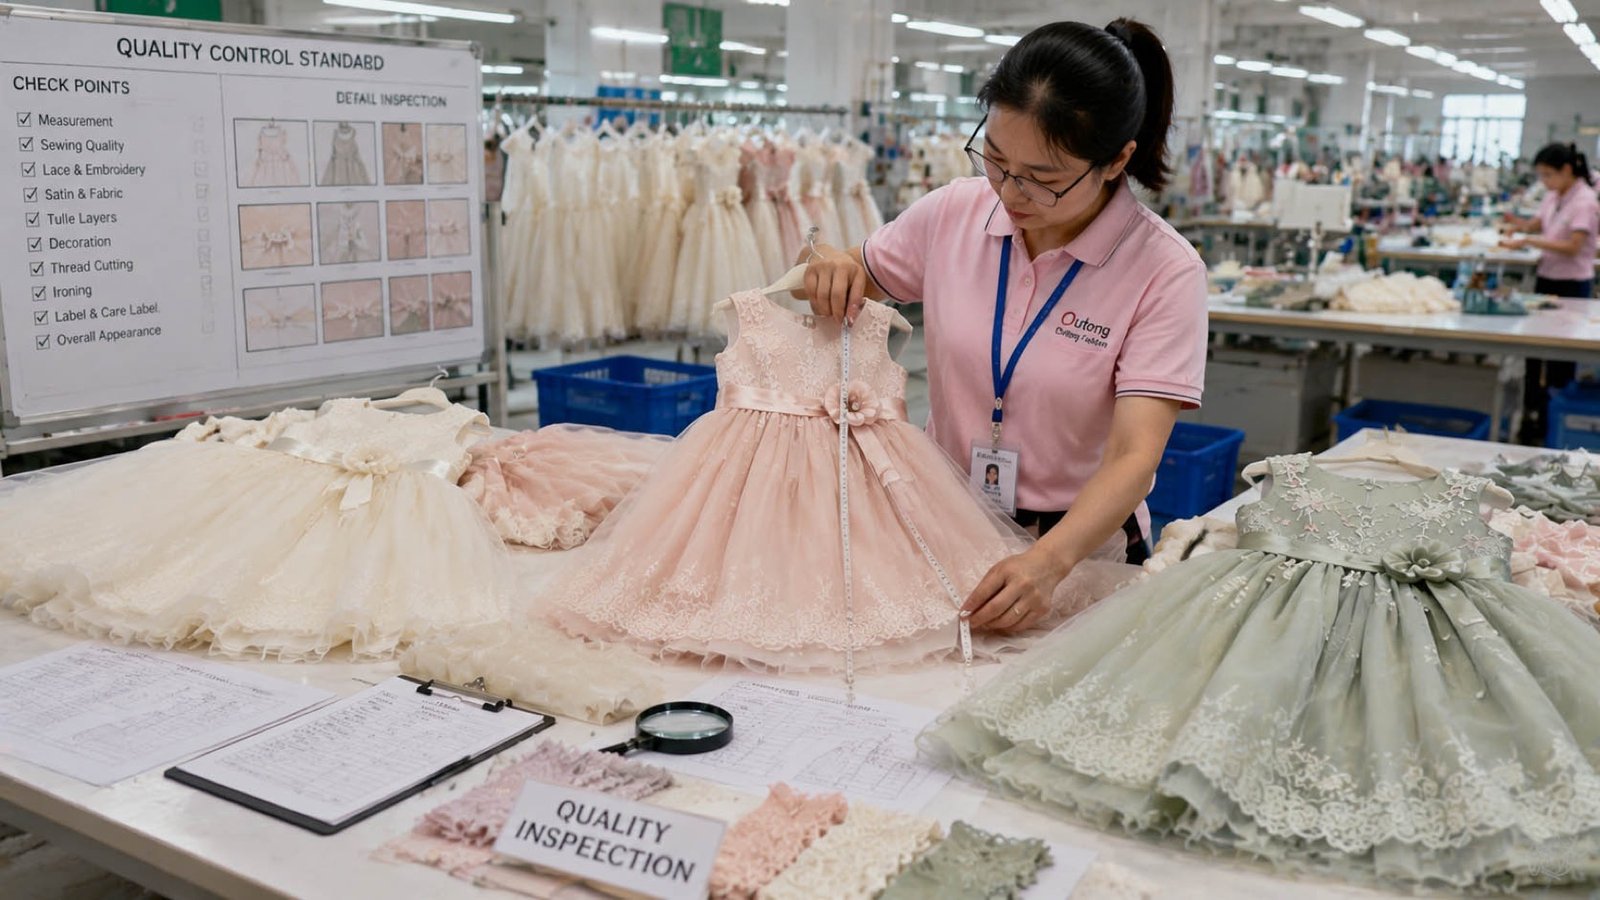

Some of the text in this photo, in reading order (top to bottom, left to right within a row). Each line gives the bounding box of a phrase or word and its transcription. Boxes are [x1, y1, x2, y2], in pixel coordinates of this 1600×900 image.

[116, 37, 202, 60] QUALITY
[210, 44, 294, 66] CONTROL
[13, 75, 130, 95] CHECK POINTS
[380, 94, 447, 108] INSPECTION
[38, 113, 113, 127] Measurement
[40, 138, 125, 154] Sewing Quality
[43, 163, 146, 177] Lace & Embroidery
[45, 187, 123, 201] Satin & Fabric
[47, 211, 117, 226] Tulle Layers
[49, 235, 111, 250] Decoration
[51, 258, 134, 274] Thread Cutting
[53, 285, 92, 298] Ironing
[55, 309, 86, 323] Label
[89, 308, 98, 320] &
[101, 305, 126, 318] Care
[1061, 311, 1111, 339] Outong
[57, 324, 162, 347] Overall Appearance
[556, 799, 672, 844] QUALITY
[515, 819, 696, 883] INSPEECTION
